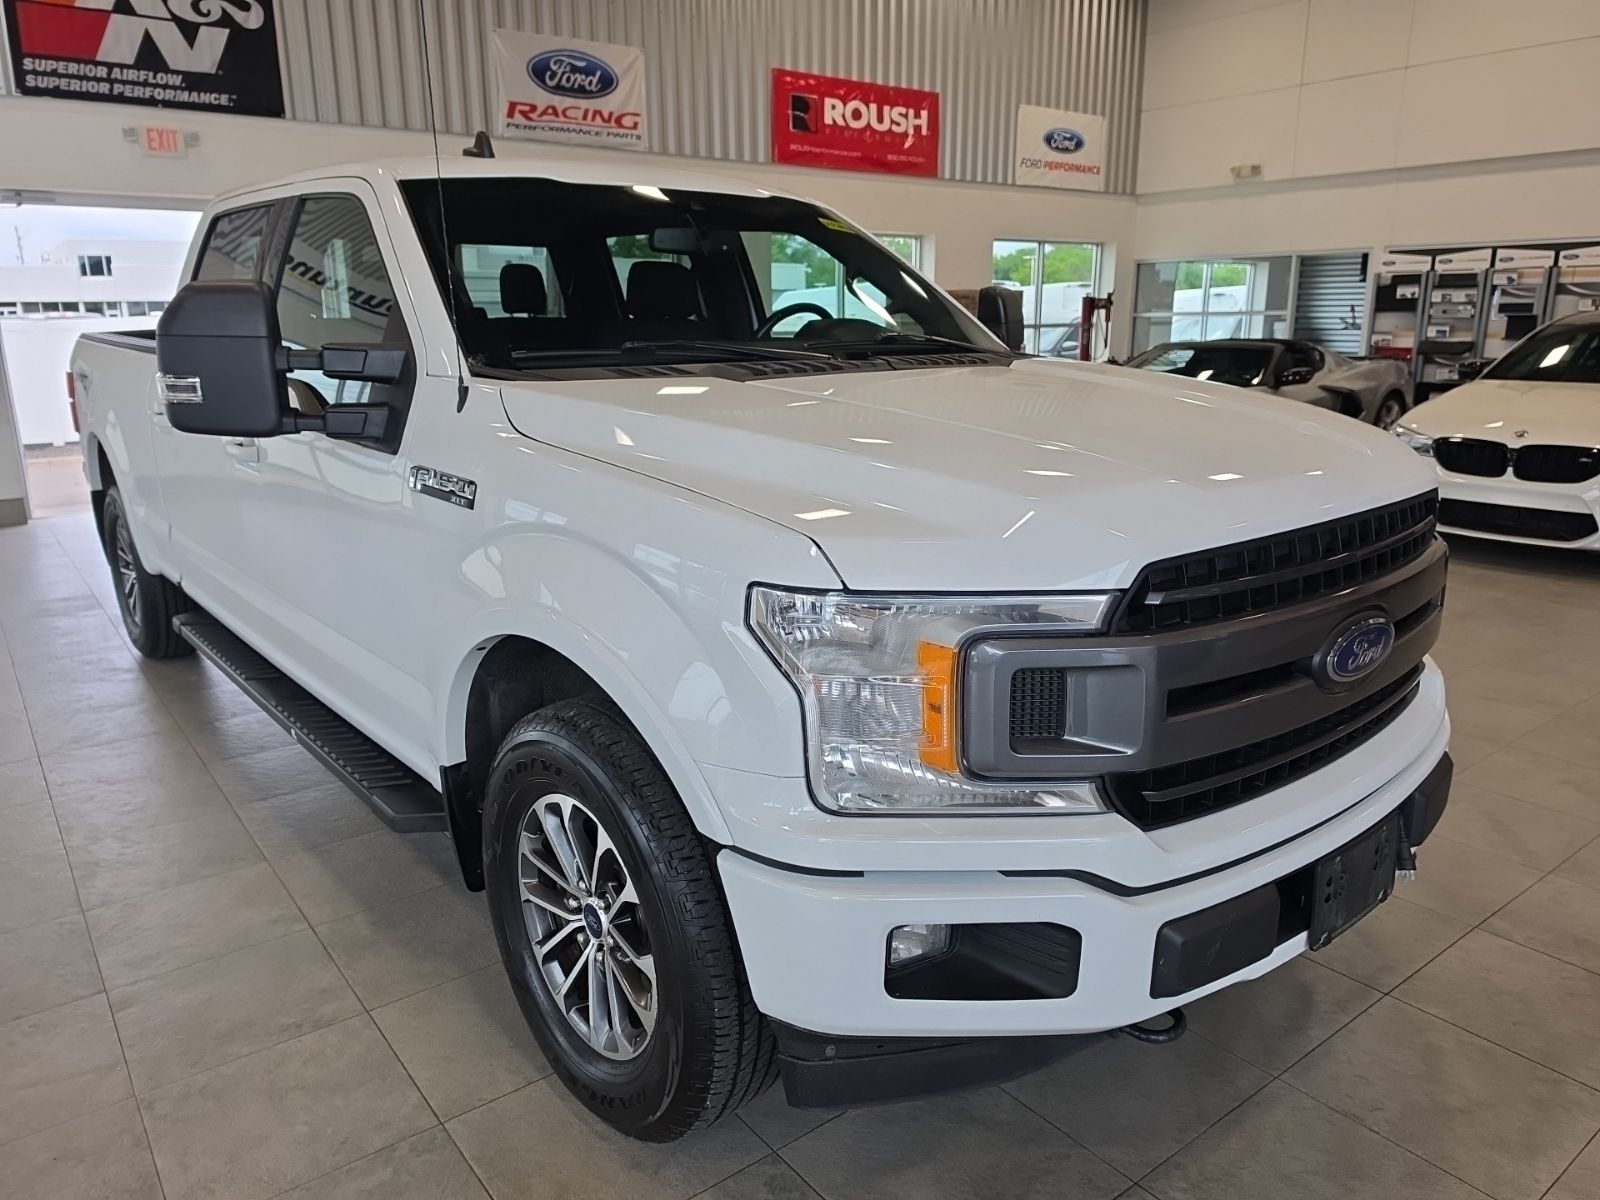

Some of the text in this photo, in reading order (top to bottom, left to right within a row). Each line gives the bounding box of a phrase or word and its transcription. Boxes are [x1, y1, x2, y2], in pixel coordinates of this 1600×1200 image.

[22, 57, 187, 87] SUPERIOR AIRFLOW.
[25, 74, 111, 95] SUPERIOR
[545, 56, 602, 92] Ford
[506, 100, 641, 130] RACING
[823, 97, 929, 136] ROUSH
[145, 127, 178, 152] EXIT
[506, 122, 642, 141] PERFORMANCE PARTS
[1050, 131, 1078, 150] Ford
[1020, 158, 1101, 175] FORD PERFORMANCE
[451, 496, 465, 505] XLT
[1347, 631, 1386, 671] Ford
